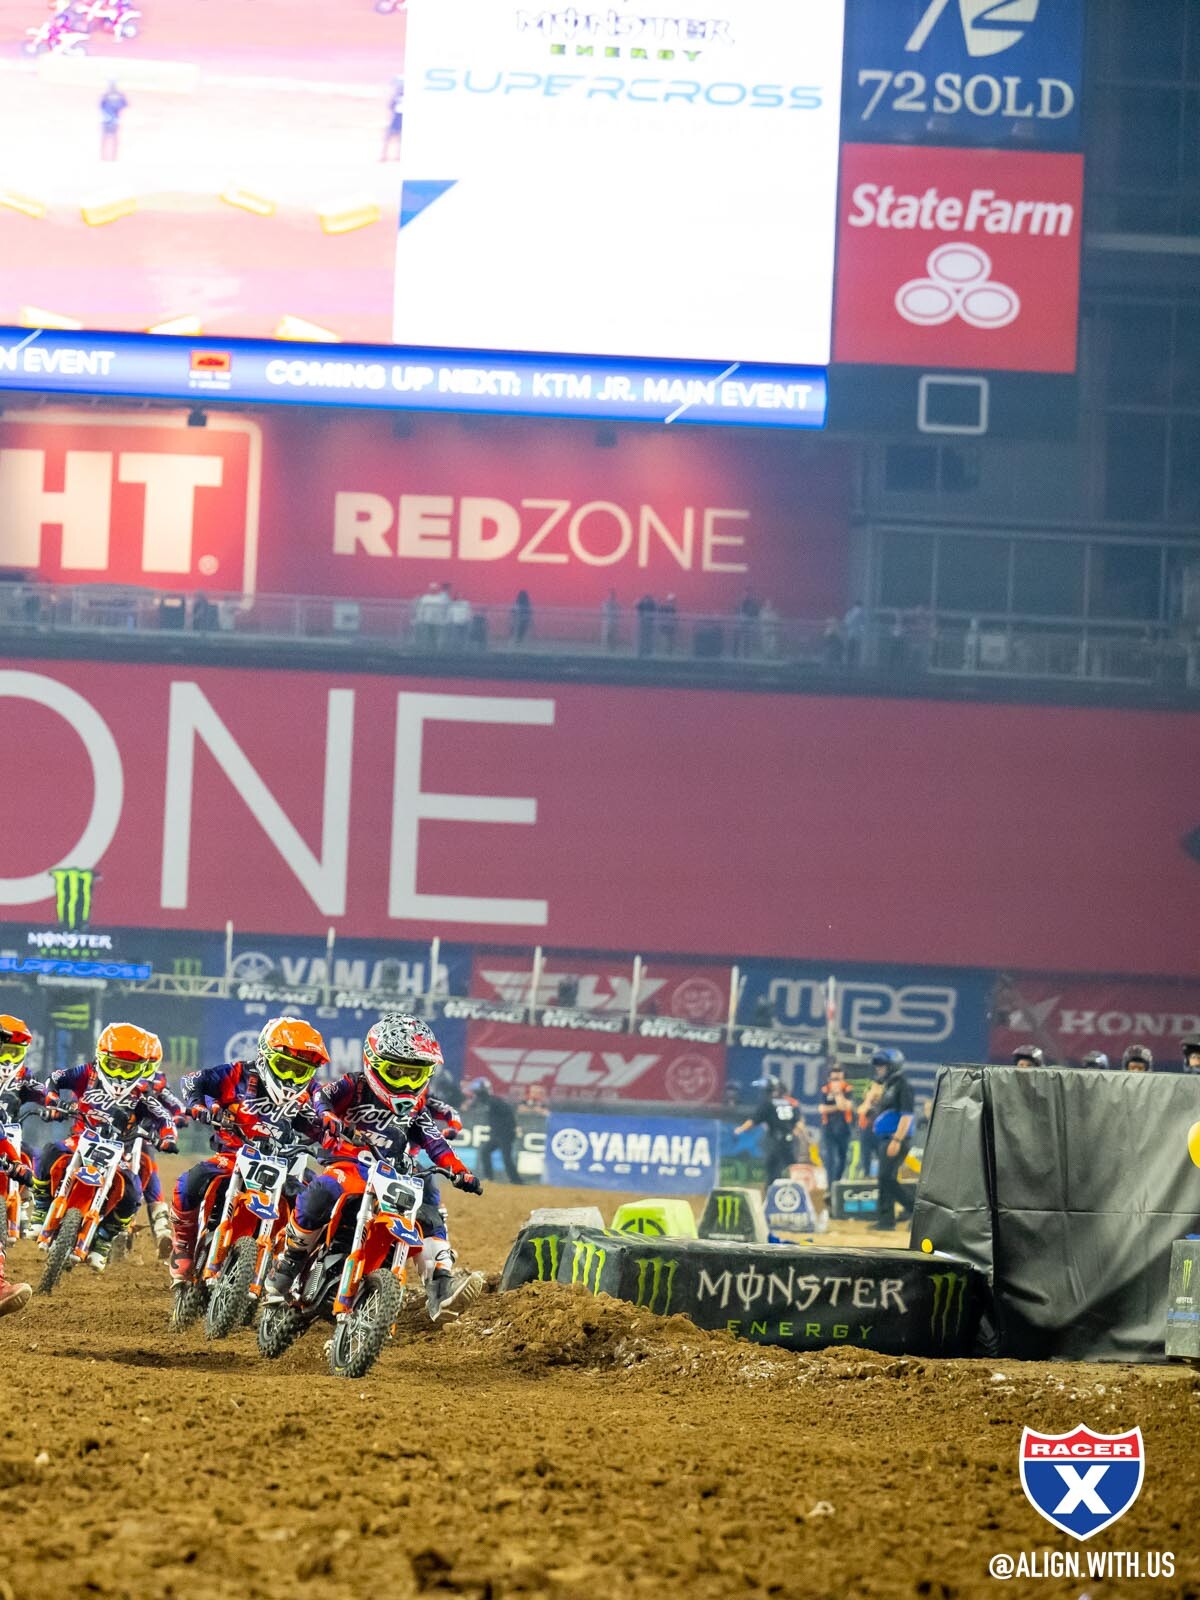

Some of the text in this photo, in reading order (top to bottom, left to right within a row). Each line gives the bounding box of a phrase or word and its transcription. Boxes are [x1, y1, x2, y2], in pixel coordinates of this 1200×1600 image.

[424, 67, 824, 110] SUPERCROSS
[23, 348, 116, 376] EVENT
[265, 359, 386, 390] COMING
[391, 366, 434, 392] UP
[438, 367, 522, 397] NEXT:
[532, 372, 592, 399] KTM
[596, 376, 636, 401] JR.
[643, 377, 716, 405] MAIN
[721, 381, 813, 410] EVENT
[332, 490, 750, 574] REDZONE
[27, 931, 113, 950] MONSTER
[240, 1097, 285, 1123] Troy
[344, 1104, 396, 1131] Troy
[587, 1131, 711, 1168] YAMAHA
[245, 1160, 281, 1189] 10
[562, 1161, 701, 1177] RACING
[697, 1263, 909, 1315] MONSTER
[727, 1319, 875, 1340] ENERGY
